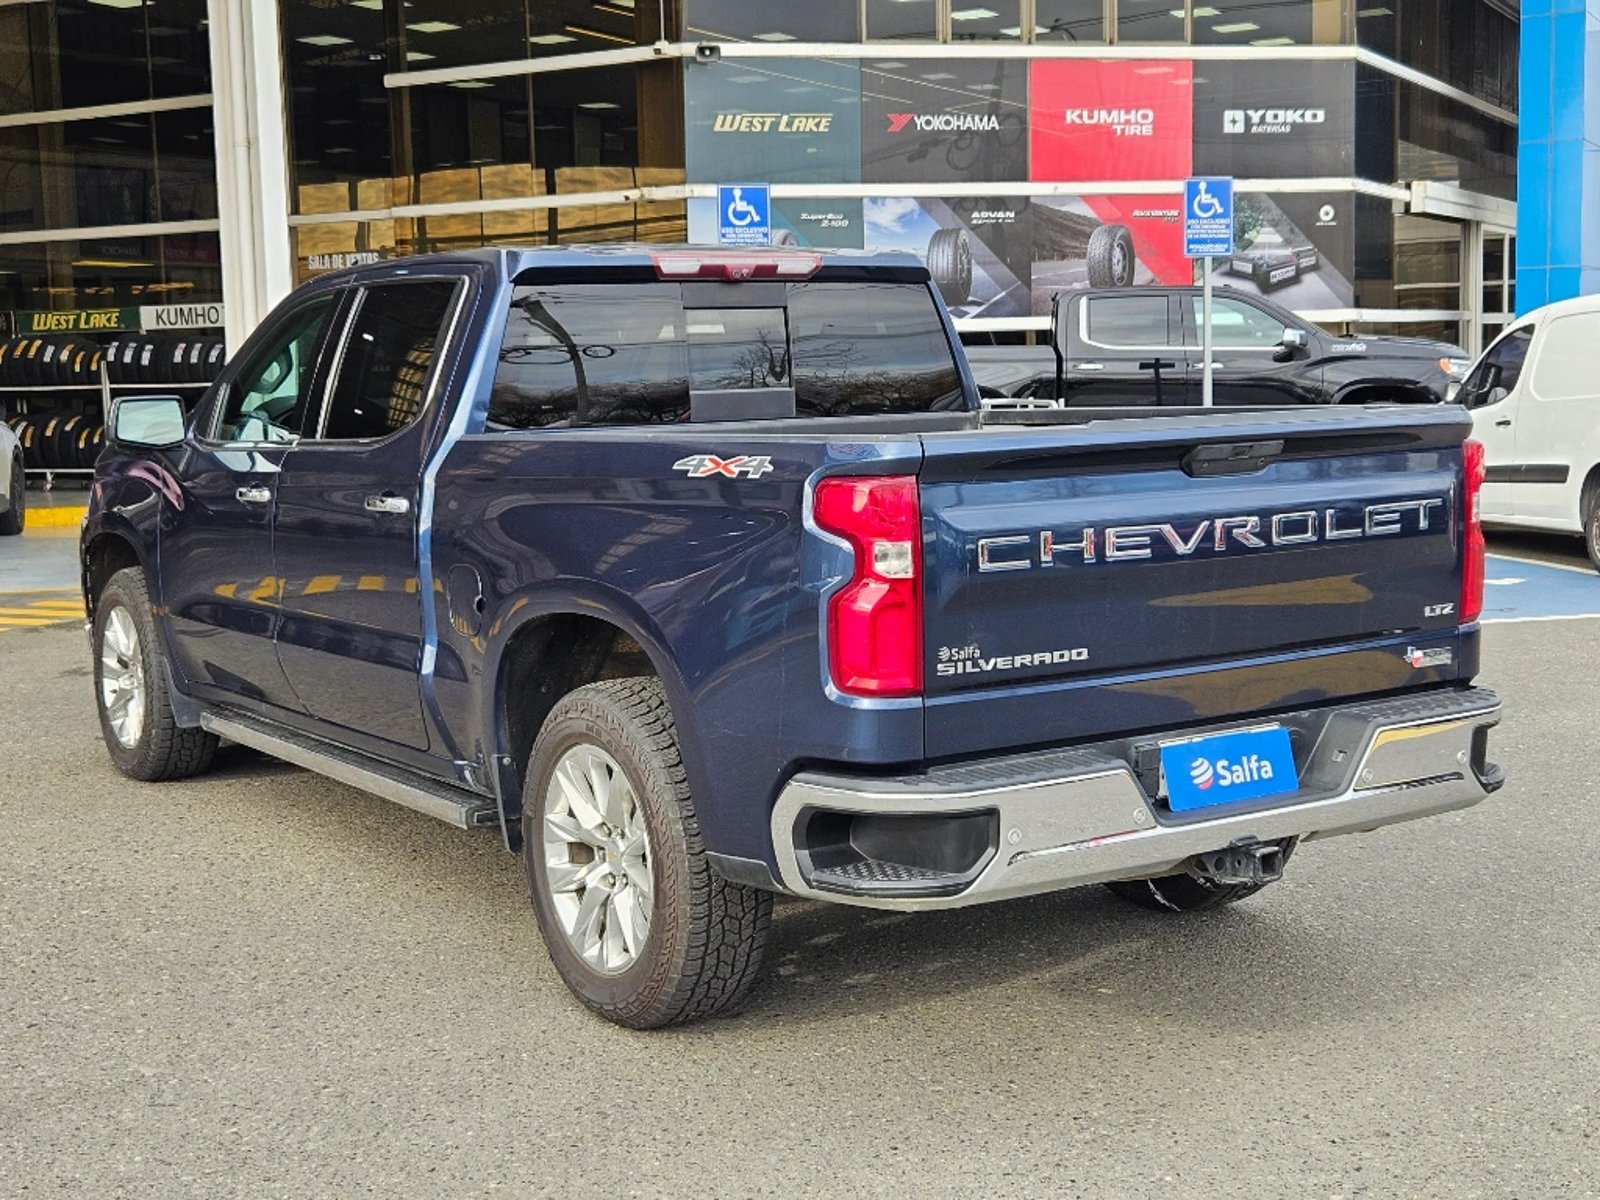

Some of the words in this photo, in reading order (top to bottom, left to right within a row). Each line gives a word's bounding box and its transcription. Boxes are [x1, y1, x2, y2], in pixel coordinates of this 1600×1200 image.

[713, 113, 781, 132] WEST
[778, 113, 833, 132] LAKE
[913, 114, 999, 130] YOKOHAMA
[1065, 108, 1154, 124] KUMHO
[1246, 109, 1325, 123] YOKO
[1112, 125, 1153, 136] TIRE
[32, 312, 77, 331] WEST
[79, 309, 120, 329] LAKE
[155, 305, 220, 326] KUMHO
[977, 498, 1443, 574] CHEVROLET
[1424, 602, 1455, 617] LTZ
[950, 643, 981, 660] Salfa
[936, 648, 1090, 676] SILVERADO
[1216, 754, 1273, 786] Salfa
